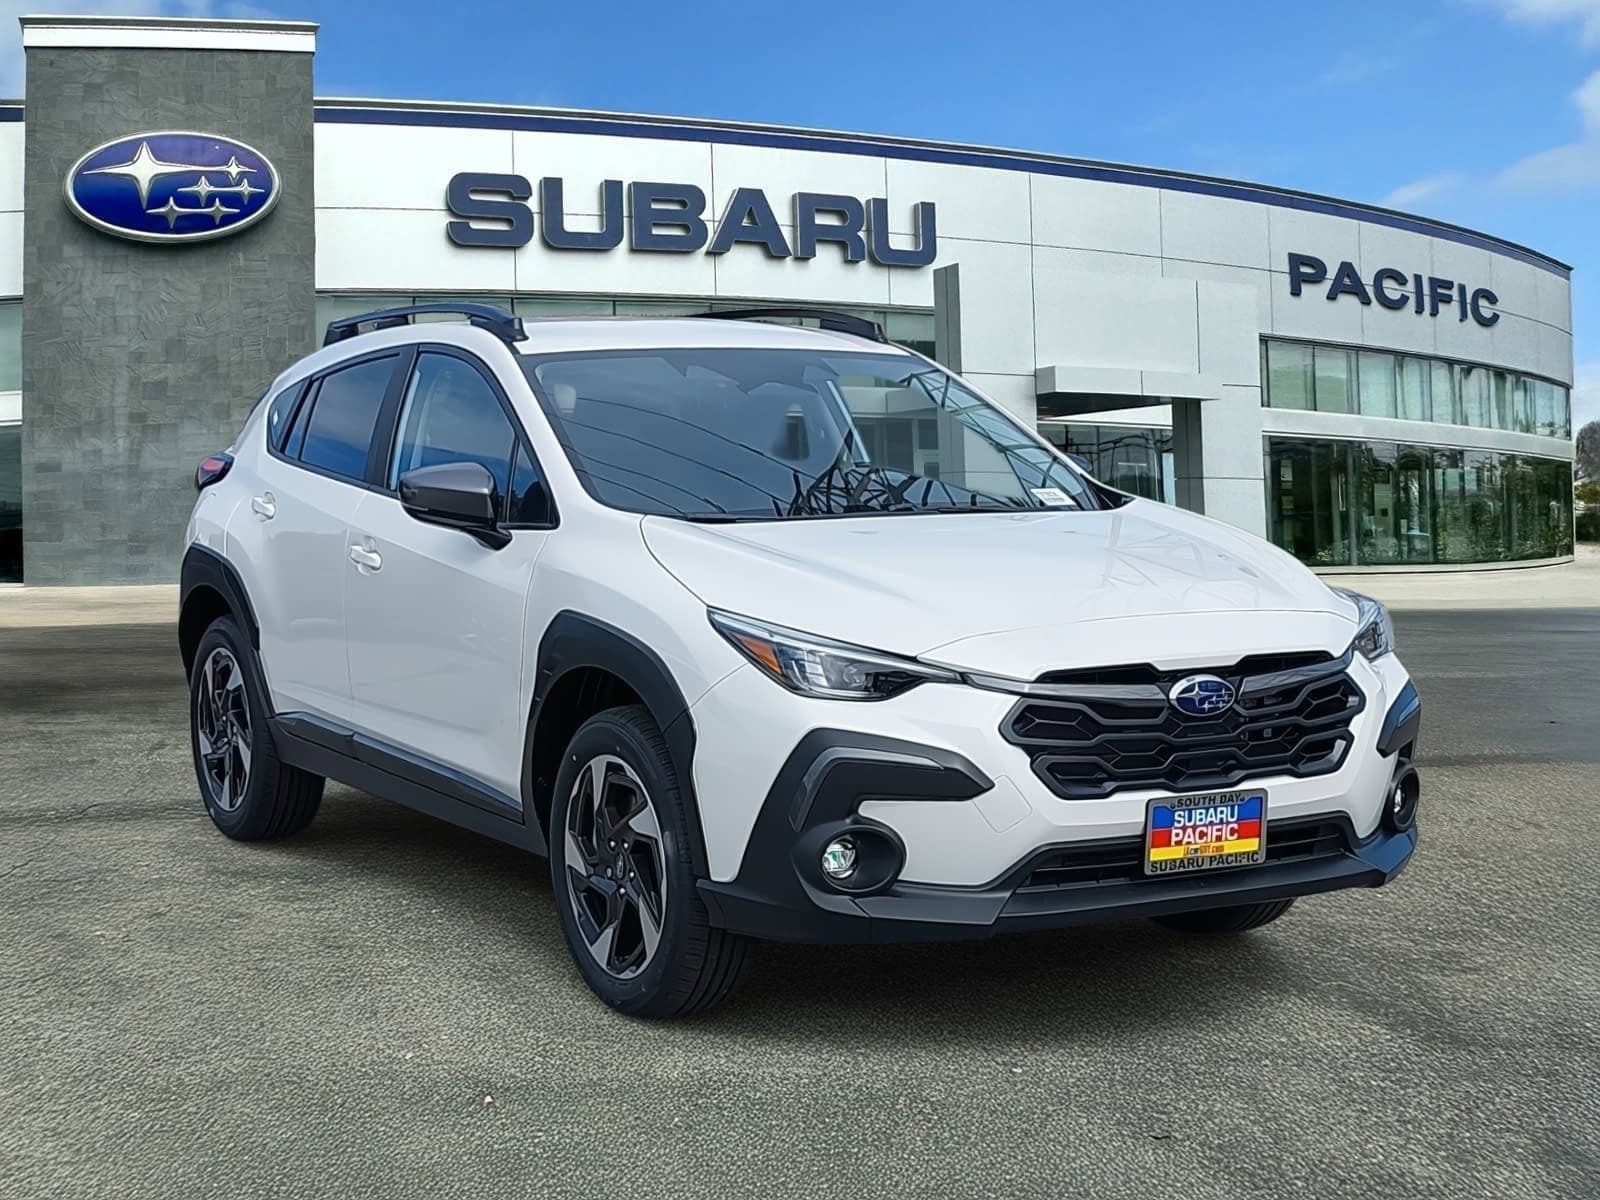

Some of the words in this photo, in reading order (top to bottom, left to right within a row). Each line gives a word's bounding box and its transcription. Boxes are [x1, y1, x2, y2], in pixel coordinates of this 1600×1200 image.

[447, 171, 937, 268] SUBARU
[1288, 252, 1500, 328] PACIFIC
[1177, 795, 1216, 808] SOUTH
[1174, 805, 1238, 828] SUBARU
[1170, 823, 1239, 846] PACIFIC
[1150, 856, 1205, 873] SUBARU
[1209, 852, 1260, 867] PACIFIC
